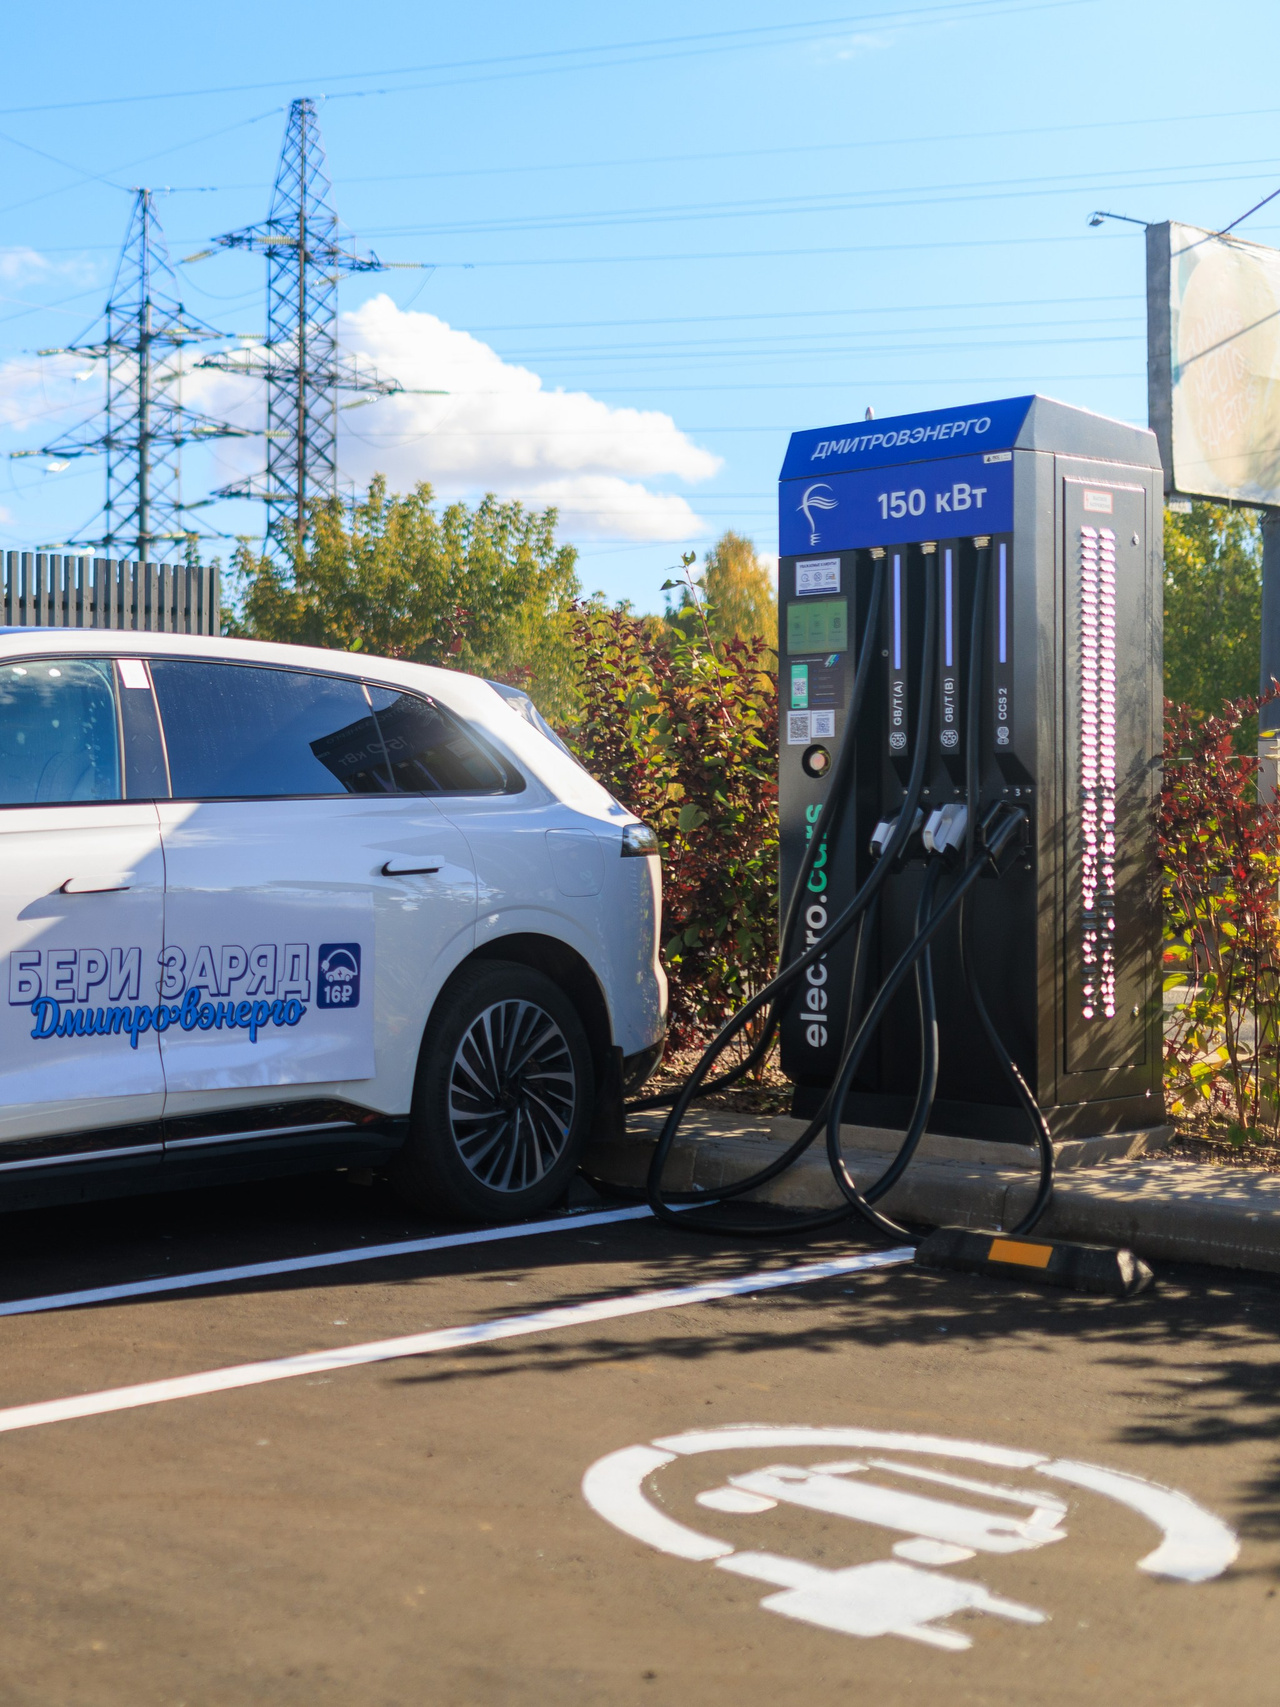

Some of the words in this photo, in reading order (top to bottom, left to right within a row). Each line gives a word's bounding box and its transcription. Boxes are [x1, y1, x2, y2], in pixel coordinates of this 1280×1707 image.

[810, 416, 992, 461] ДМИТРОВЭНЕРГО
[877, 488, 926, 520] 150
[935, 484, 988, 514] кВт
[998, 697, 1008, 720] CCS
[1014, 788, 1021, 797] 3
[8, 946, 142, 1005] БЕРИ
[155, 942, 312, 1003] ЗАРЯД
[30, 986, 308, 1050] Дмитровэнерго
